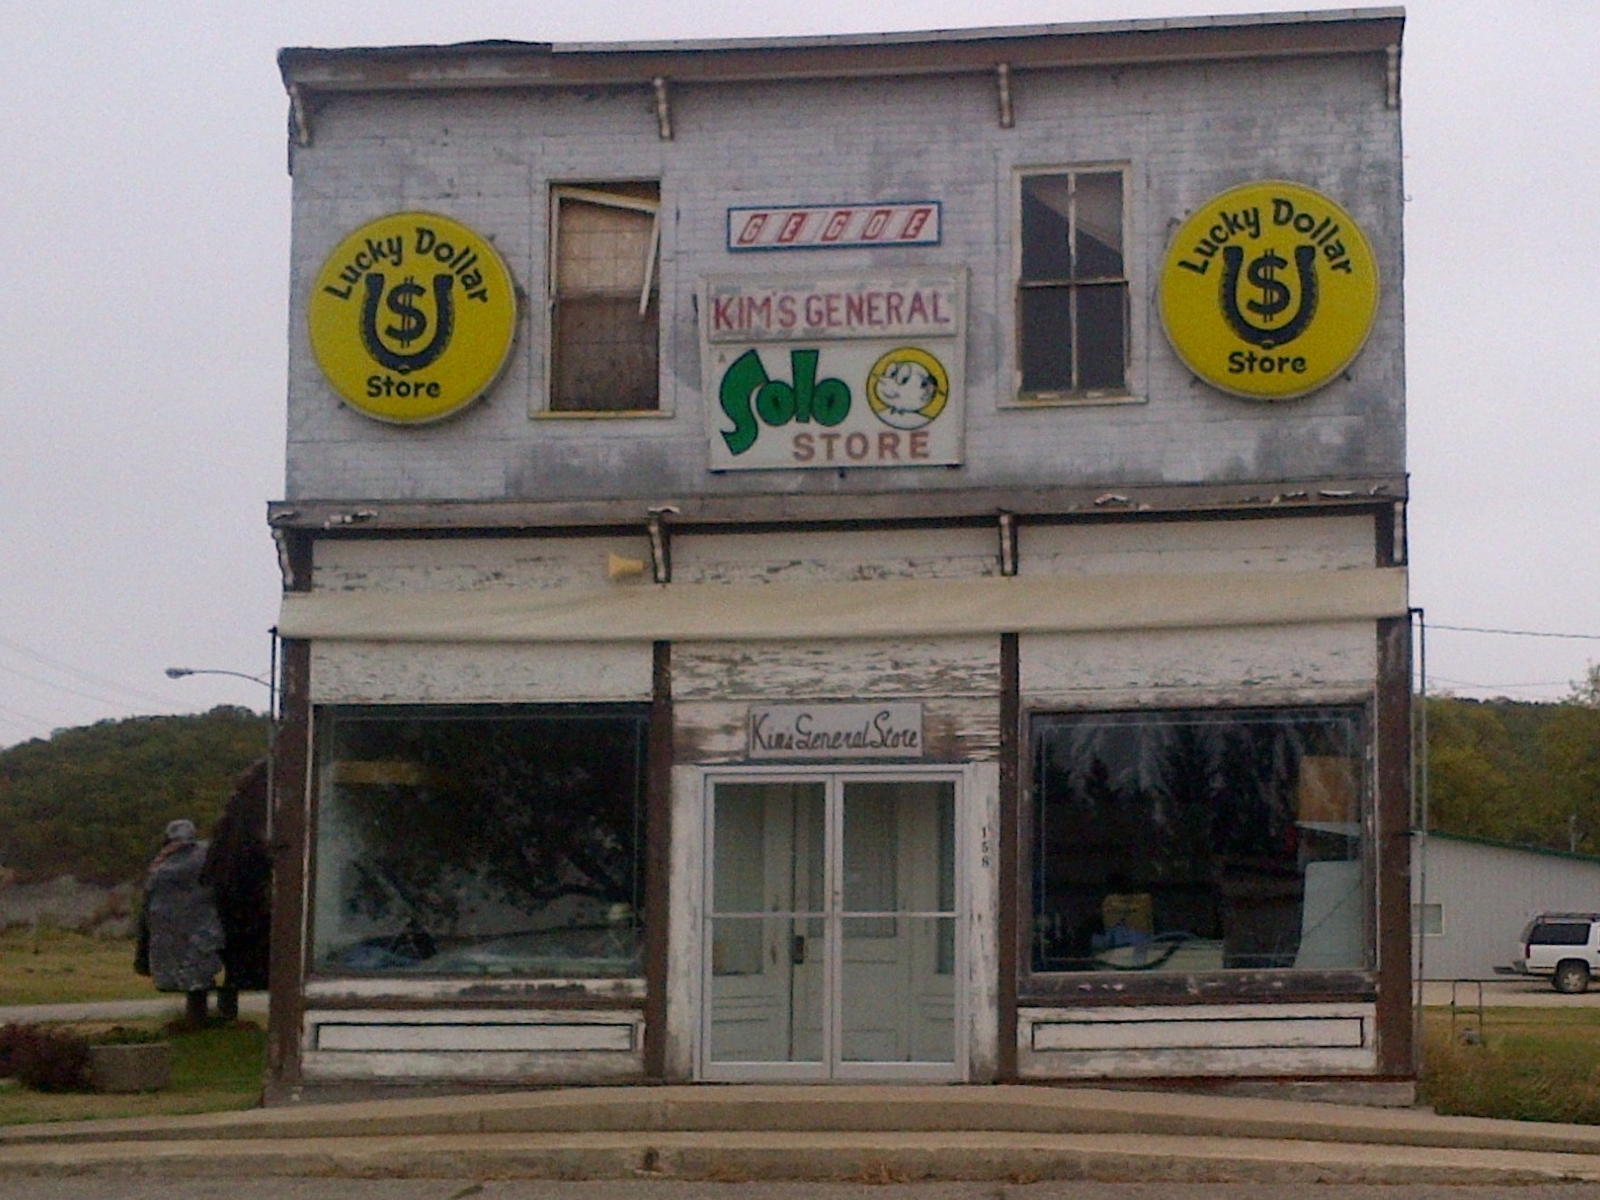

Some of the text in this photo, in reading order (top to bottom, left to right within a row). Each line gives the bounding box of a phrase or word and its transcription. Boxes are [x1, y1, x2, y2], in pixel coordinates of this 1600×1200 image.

[1177, 198, 1352, 275] Lucky Dollar
[324, 227, 488, 303] Lucky Dollar
[714, 290, 950, 330] KIM'S GENERAL
[1228, 352, 1307, 373] Store
[366, 375, 441, 398] Store
[719, 349, 851, 456] Solo
[793, 431, 930, 462] STORE
[795, 713, 870, 750] General
[869, 710, 917, 748] Store
